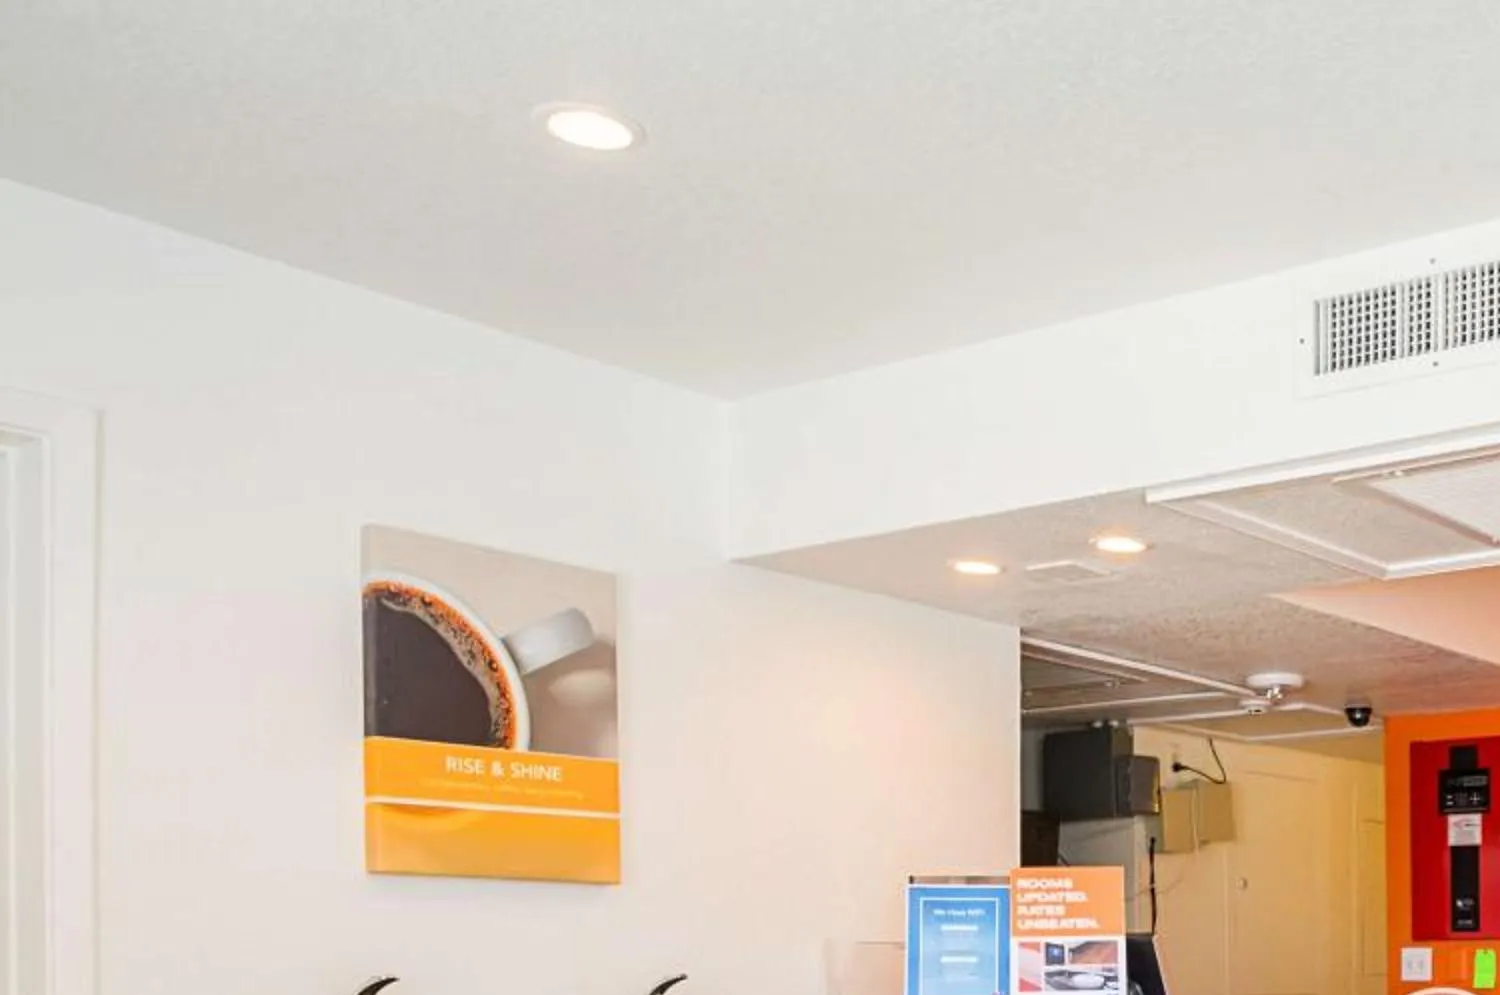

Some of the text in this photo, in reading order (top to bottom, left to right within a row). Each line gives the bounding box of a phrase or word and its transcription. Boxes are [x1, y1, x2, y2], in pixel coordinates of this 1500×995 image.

[445, 755, 562, 781] RISE & SHINE
[1017, 878, 1073, 891] ROOMS
[1017, 905, 1066, 916] RATES
[1017, 917, 1100, 930] UNBEATEN.
